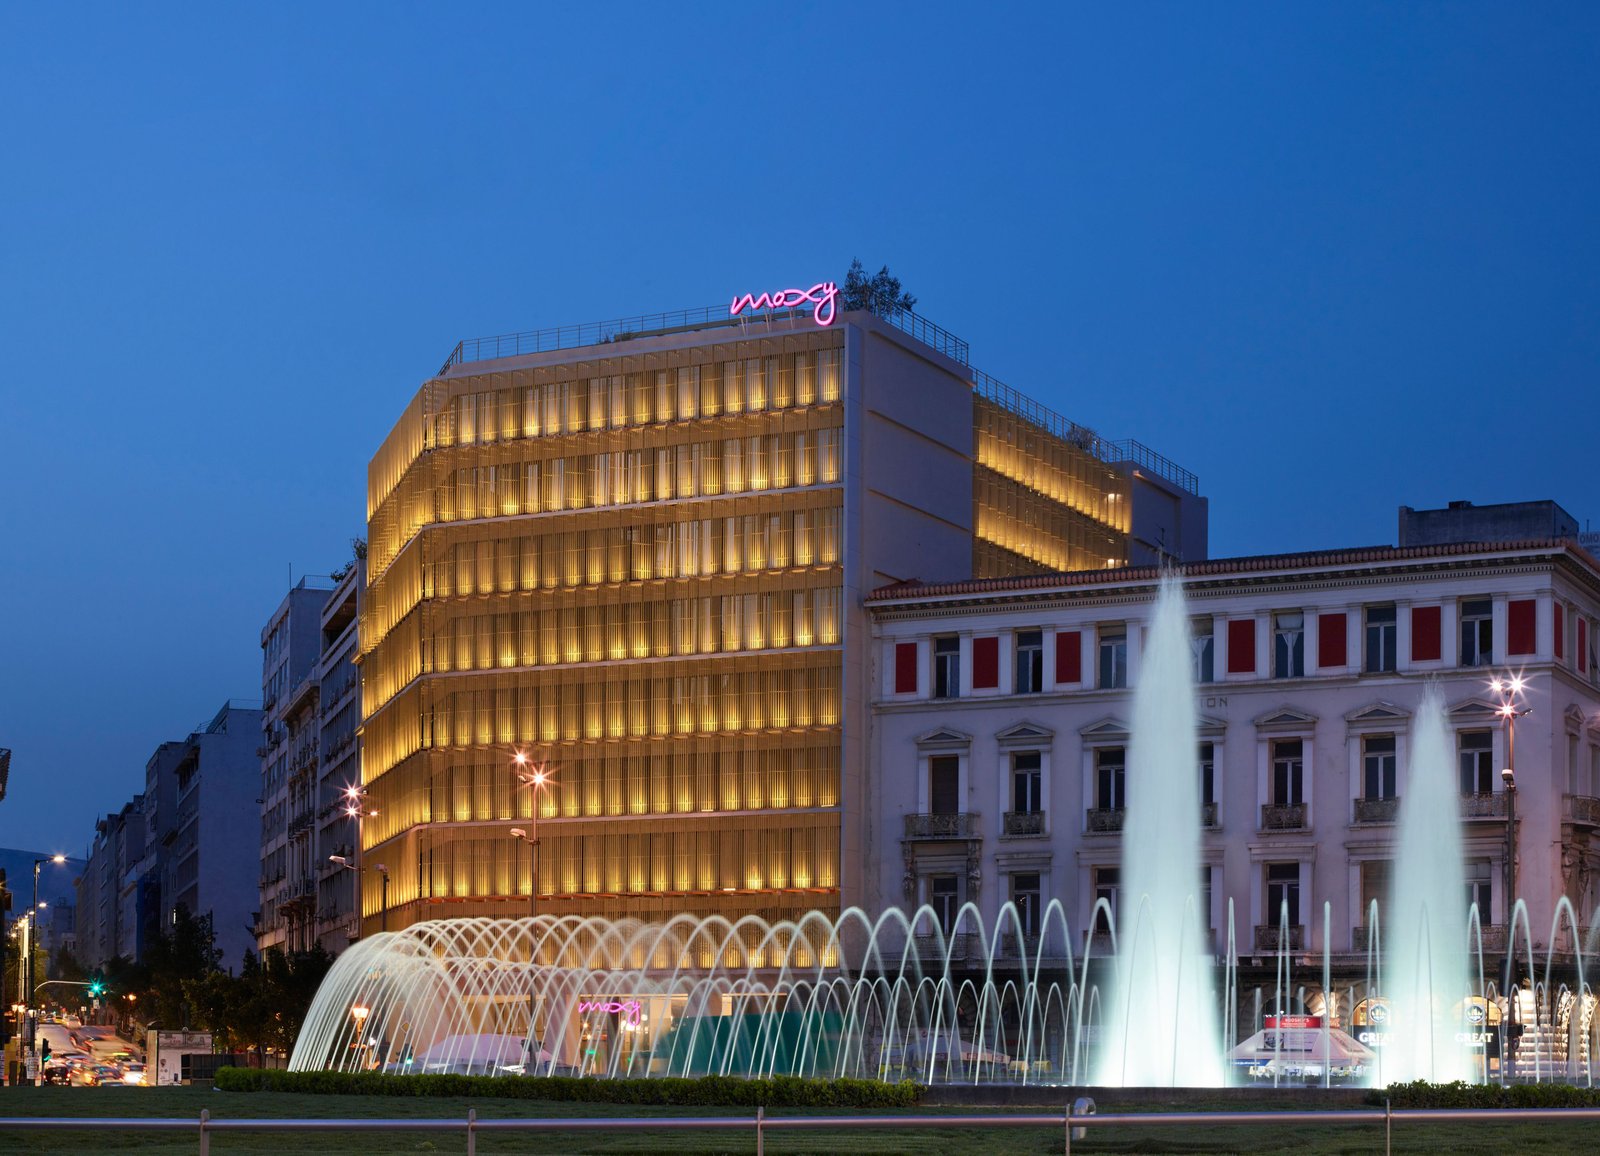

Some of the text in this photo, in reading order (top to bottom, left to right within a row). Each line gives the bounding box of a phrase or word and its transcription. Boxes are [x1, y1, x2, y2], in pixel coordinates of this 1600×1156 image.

[731, 281, 840, 326] moxy
[578, 1000, 641, 1026] moxy
[1455, 1032, 1494, 1043] GREAT
